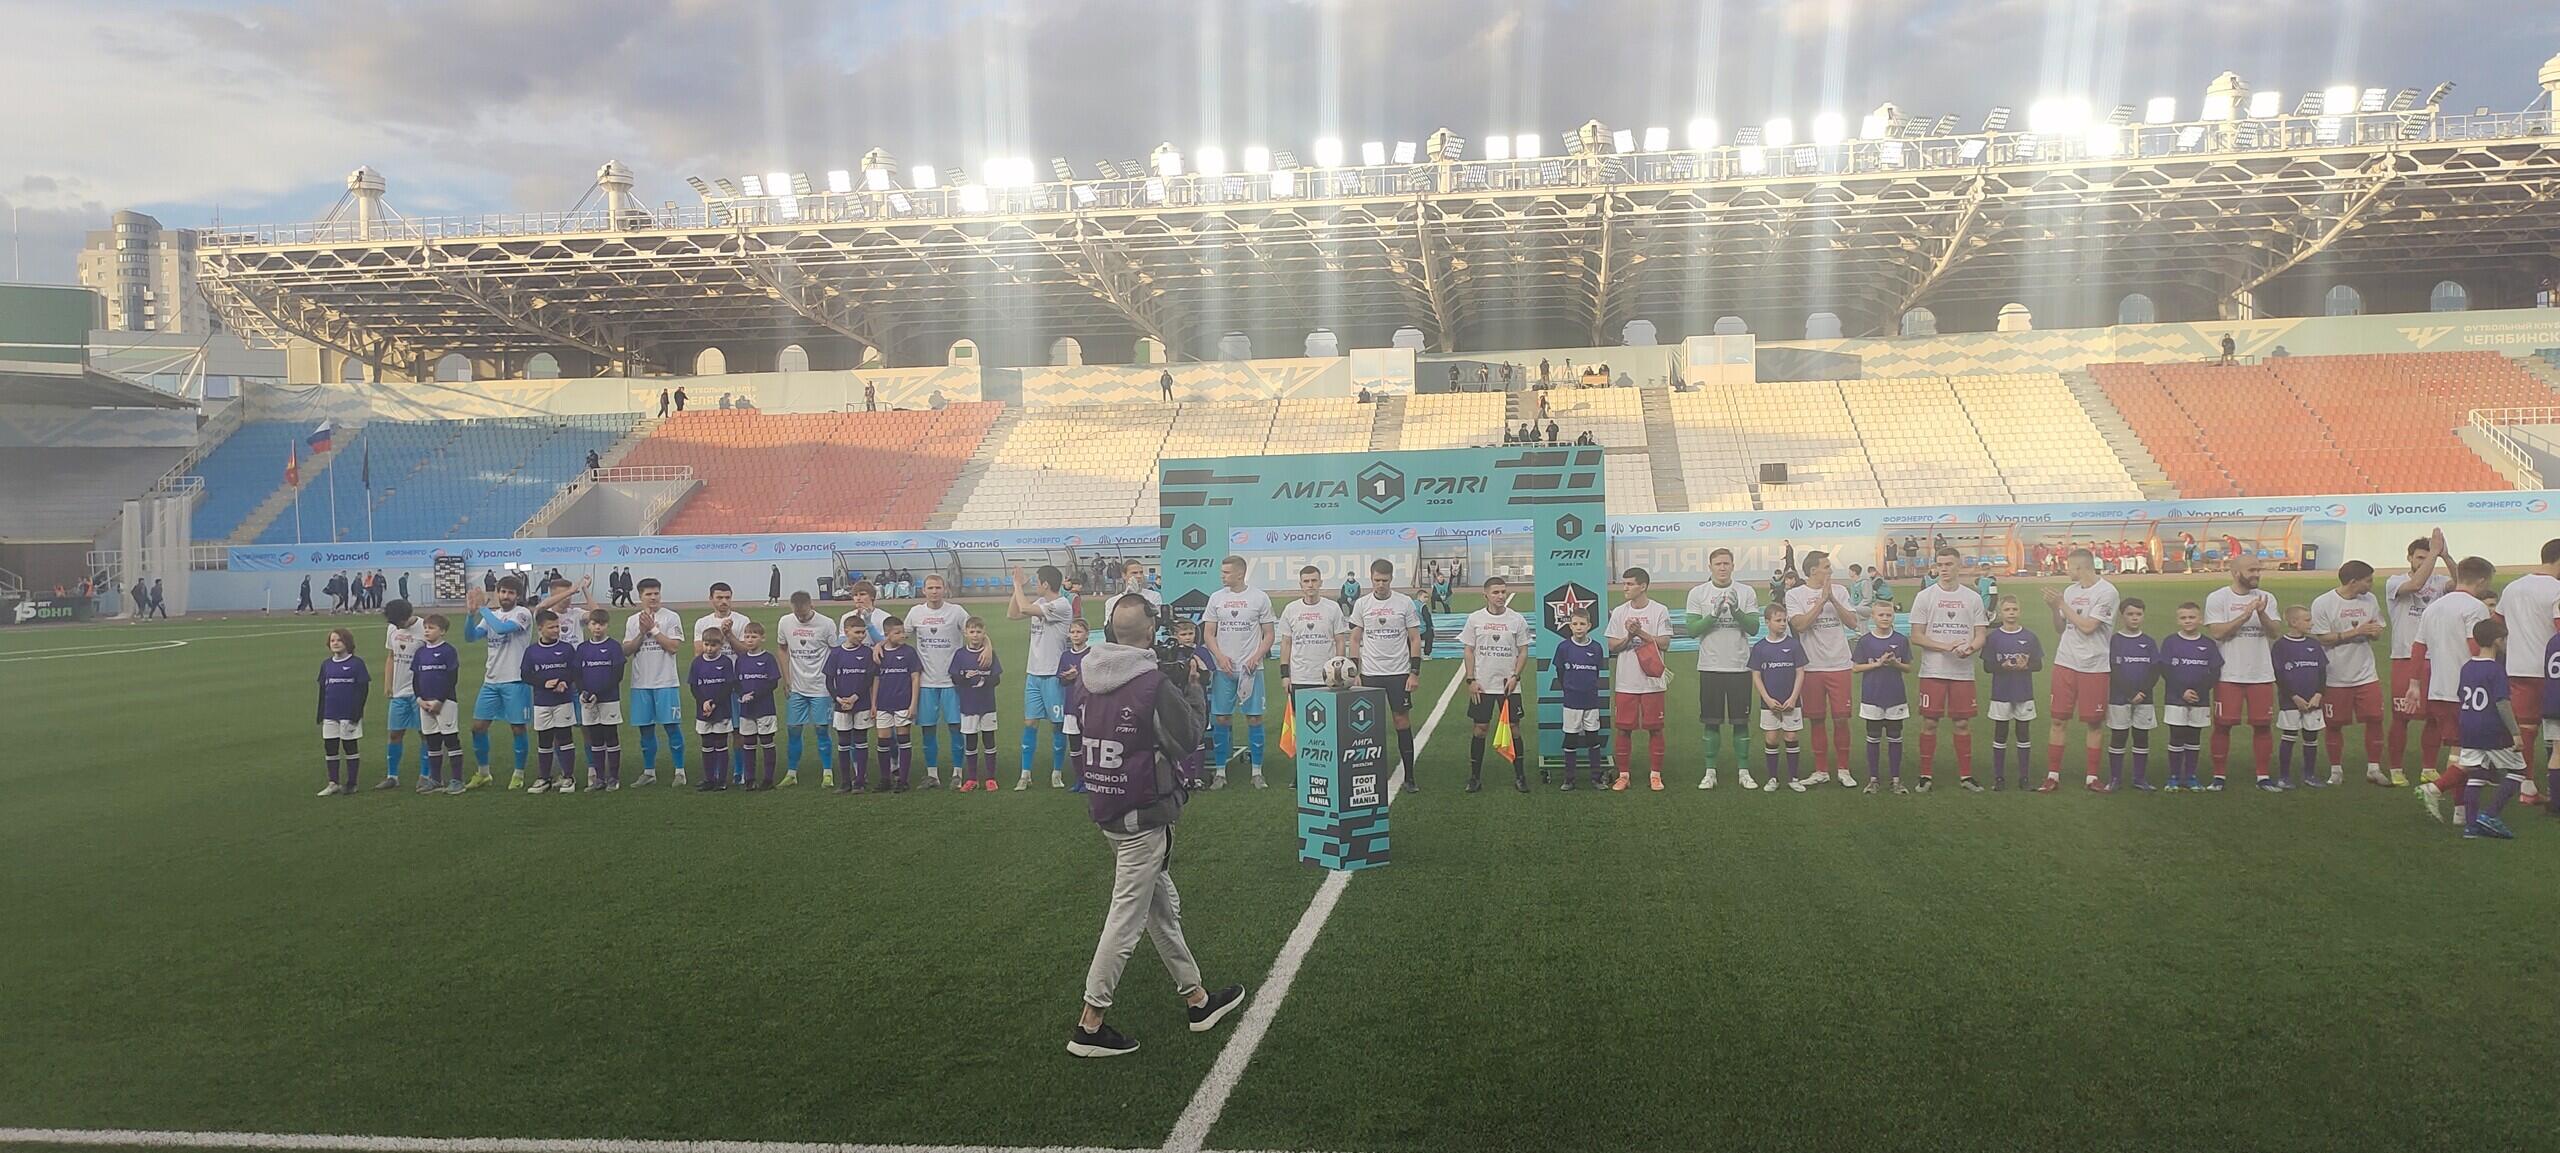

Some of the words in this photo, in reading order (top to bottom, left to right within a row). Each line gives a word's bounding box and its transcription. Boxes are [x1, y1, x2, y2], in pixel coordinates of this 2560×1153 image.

[2463, 332, 2560, 345] ЧЕЛЯБИНСК
[1272, 480, 1349, 499] ЛИГА
[1373, 479, 1385, 496] 1
[1413, 475, 1488, 496] PARI
[2267, 505, 2321, 513] ФОРЭНЕРГО
[2388, 502, 2447, 515] Уралсиб
[2467, 500, 2522, 508] ФОРЭНЕРГО
[1883, 515, 1934, 523] ФОРЭНЕРГО
[2071, 510, 2123, 518] ФОРЭНЕРГО
[1629, 523, 1681, 534] Уралсиб
[1698, 520, 1748, 528] ФОРЭНЕРГО
[1807, 518, 1861, 530] Уралсиб
[1283, 531, 1332, 543] Уралсиб
[633, 545, 679, 555] Уралсиб
[790, 542, 836, 552] Уралсиб
[326, 552, 370, 562] Уралсиб
[477, 548, 522, 559] Уралсиб
[1549, 549, 1590, 560] PARI
[1175, 558, 1214, 568] PARI
[14, 601, 37, 624] 15
[37, 607, 72, 618] ФНЛ
[2461, 686, 2489, 711] 20
[1308, 738, 1326, 747] ЛИГА
[1352, 738, 1374, 747] ЛИГА
[1081, 736, 1124, 769] ТВ
[1301, 747, 1333, 762] PARI
[1343, 746, 1382, 763] PARI
[1310, 776, 1327, 786] FOOT
[1355, 776, 1375, 785] FOOT
[1311, 787, 1326, 795] BALL
[1355, 785, 1373, 796] BALL
[1308, 796, 1329, 806] MANIA
[1352, 795, 1377, 806] MANIA
